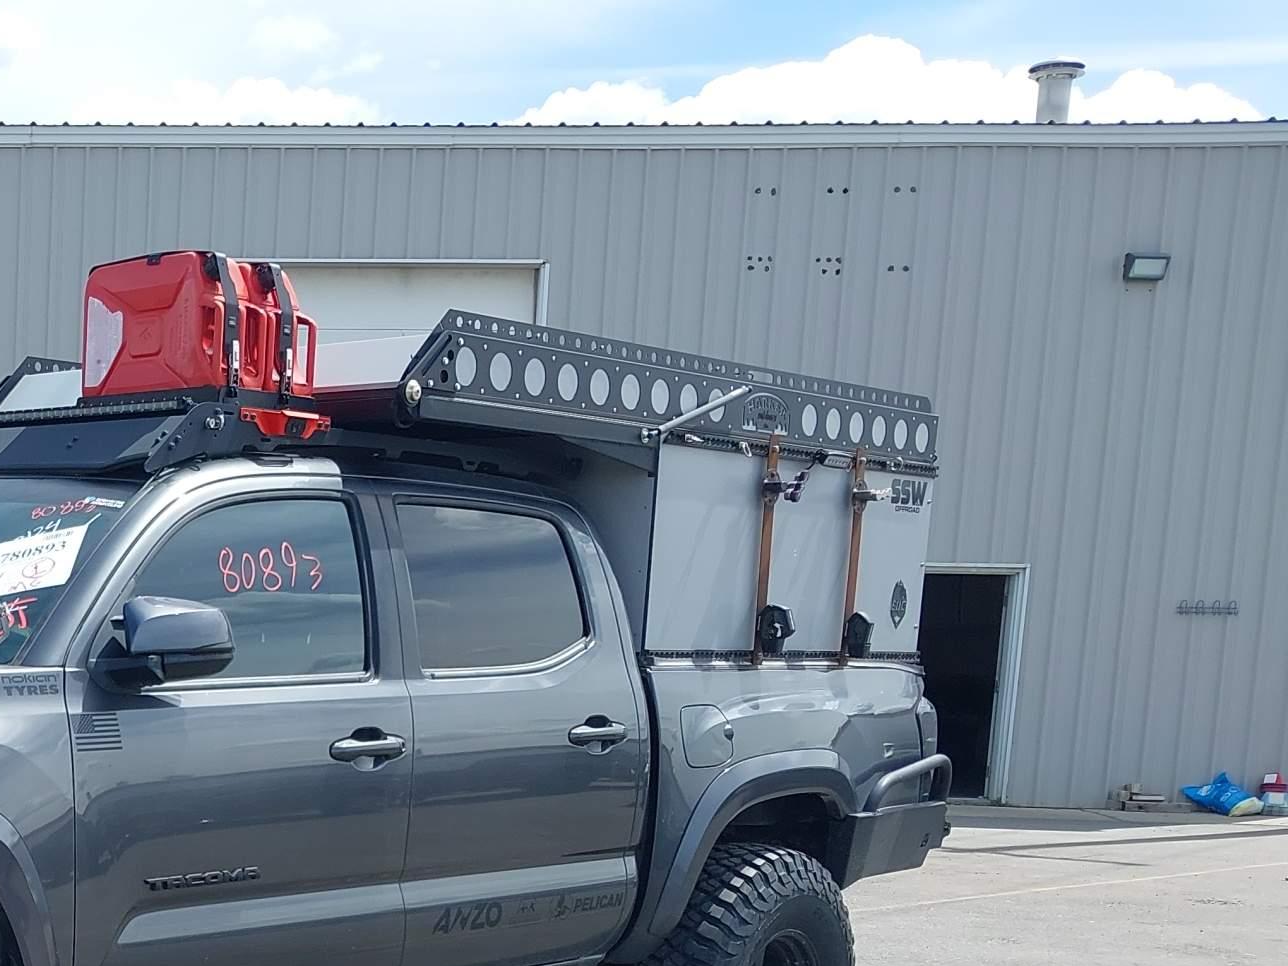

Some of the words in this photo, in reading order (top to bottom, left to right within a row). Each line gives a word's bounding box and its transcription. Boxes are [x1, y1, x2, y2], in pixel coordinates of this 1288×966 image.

[890, 478, 929, 507] SSW
[894, 504, 921, 514] OFFROAD
[219, 541, 323, 593] 80893
[0, 674, 57, 684] nokian
[3, 684, 59, 696] TYRES
[143, 866, 261, 891] TACOMA
[572, 892, 624, 913] PELICAN
[431, 902, 503, 935] ANZO
